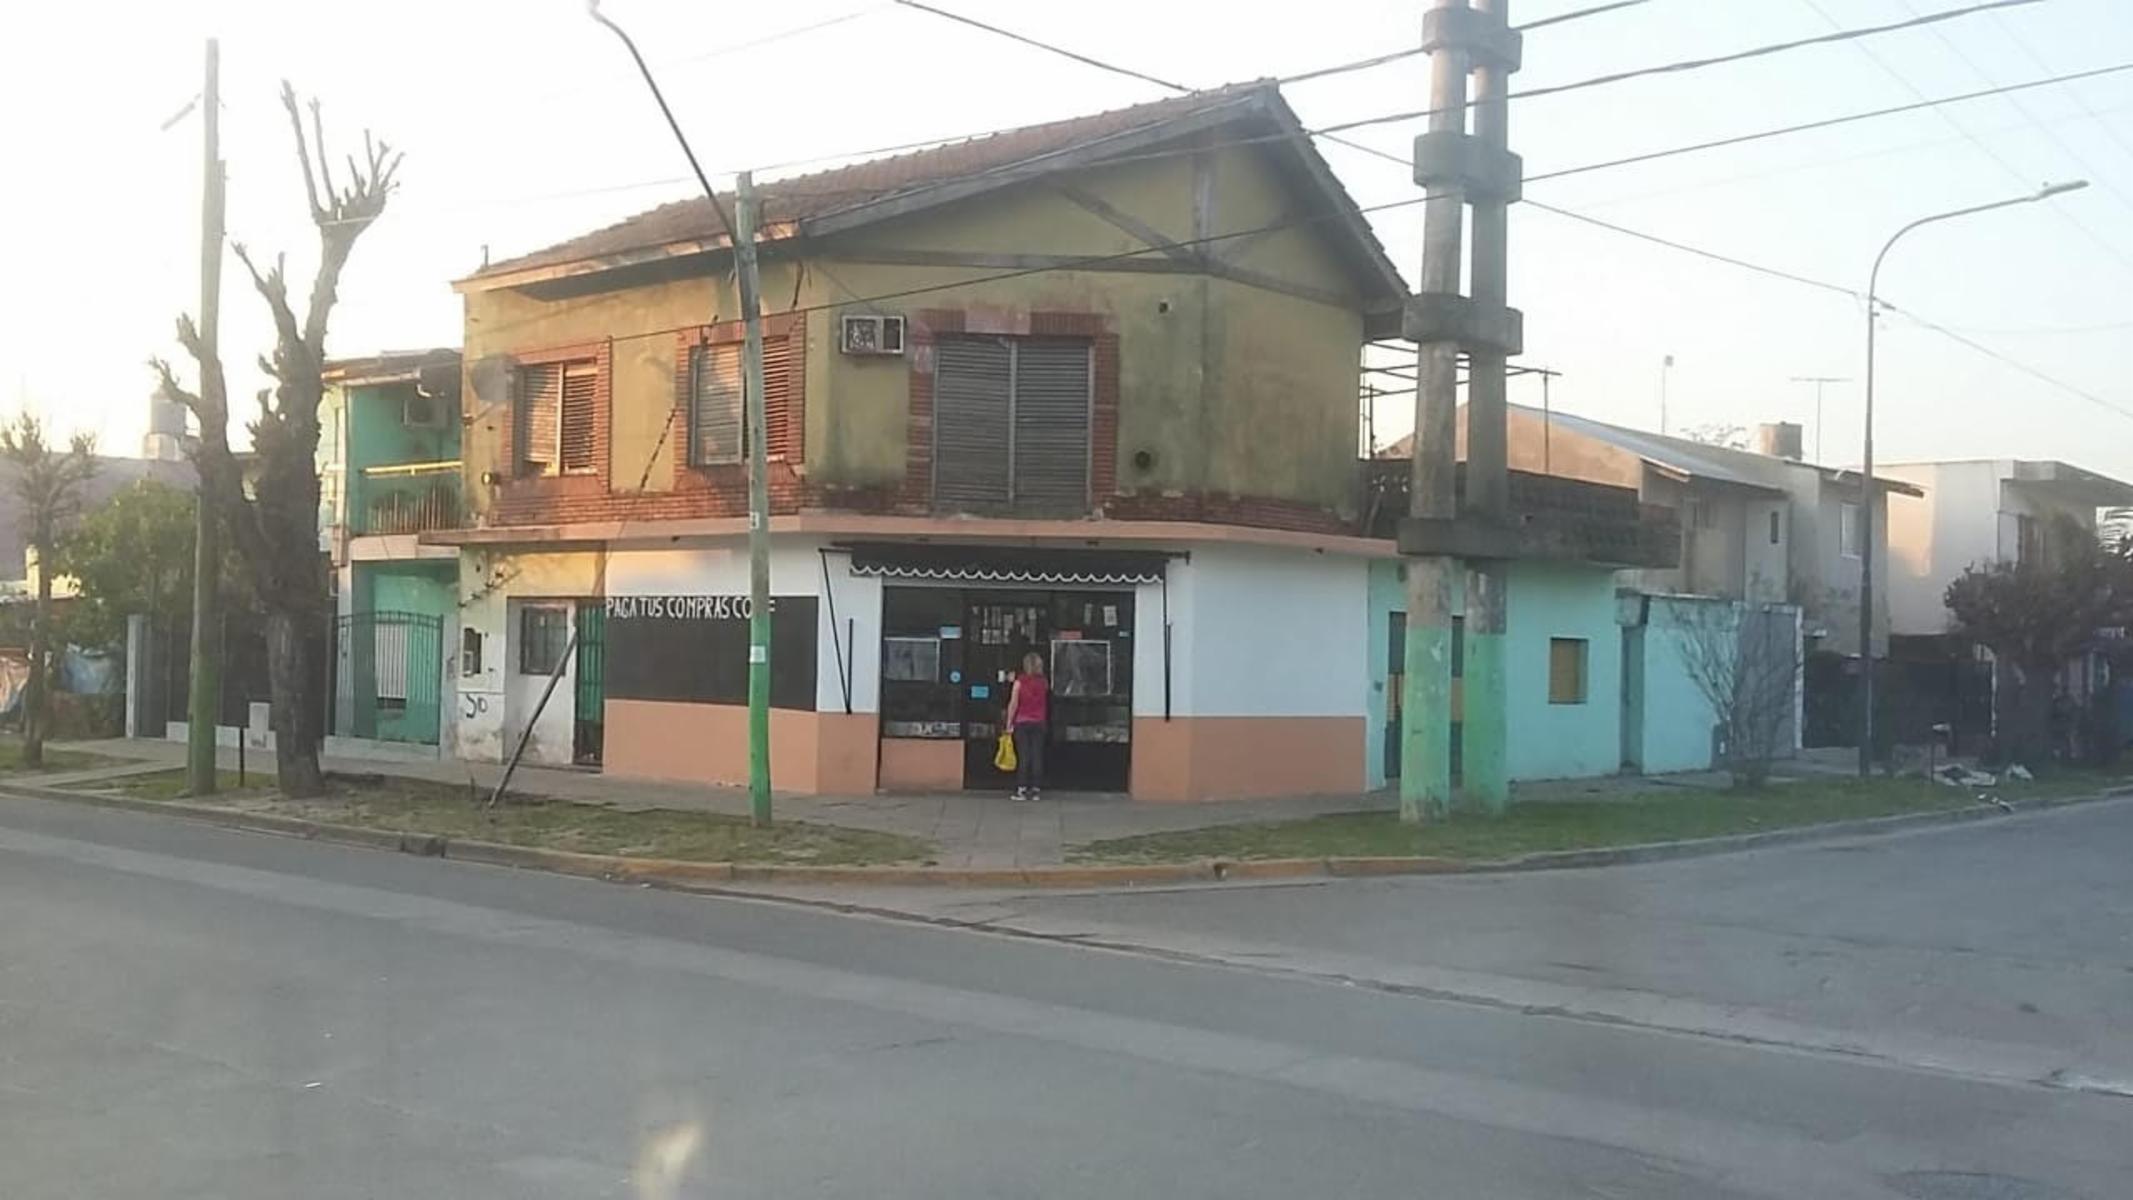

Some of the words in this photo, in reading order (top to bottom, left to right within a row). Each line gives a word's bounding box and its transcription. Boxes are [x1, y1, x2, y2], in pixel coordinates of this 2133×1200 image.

[606, 598, 637, 618] PAGA
[639, 598, 663, 617] TUS
[666, 597, 730, 619] COMPRAS
